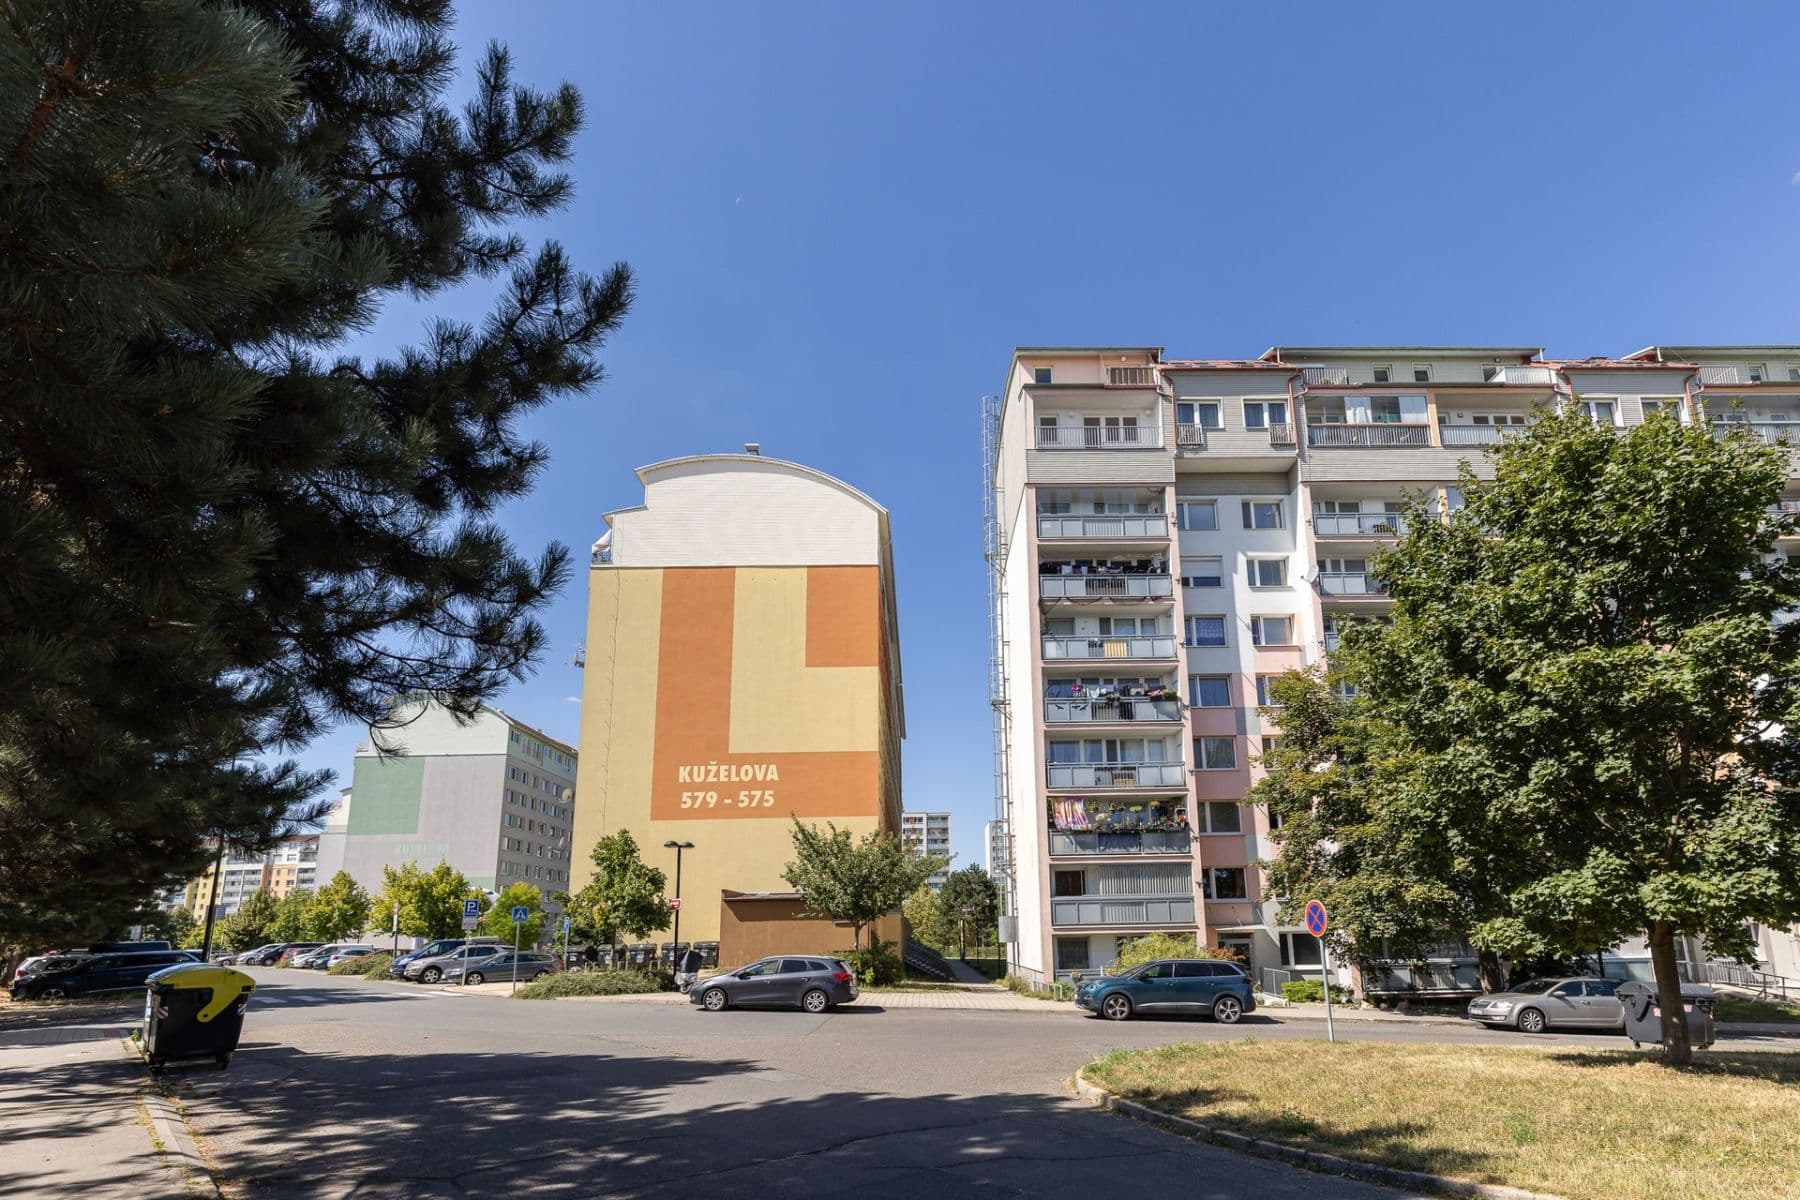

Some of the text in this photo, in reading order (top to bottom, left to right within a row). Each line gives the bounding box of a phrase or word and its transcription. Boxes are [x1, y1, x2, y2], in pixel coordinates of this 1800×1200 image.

[679, 760, 779, 783] KUŽELOVA
[681, 791, 718, 809] 579
[737, 790, 775, 808] 575
